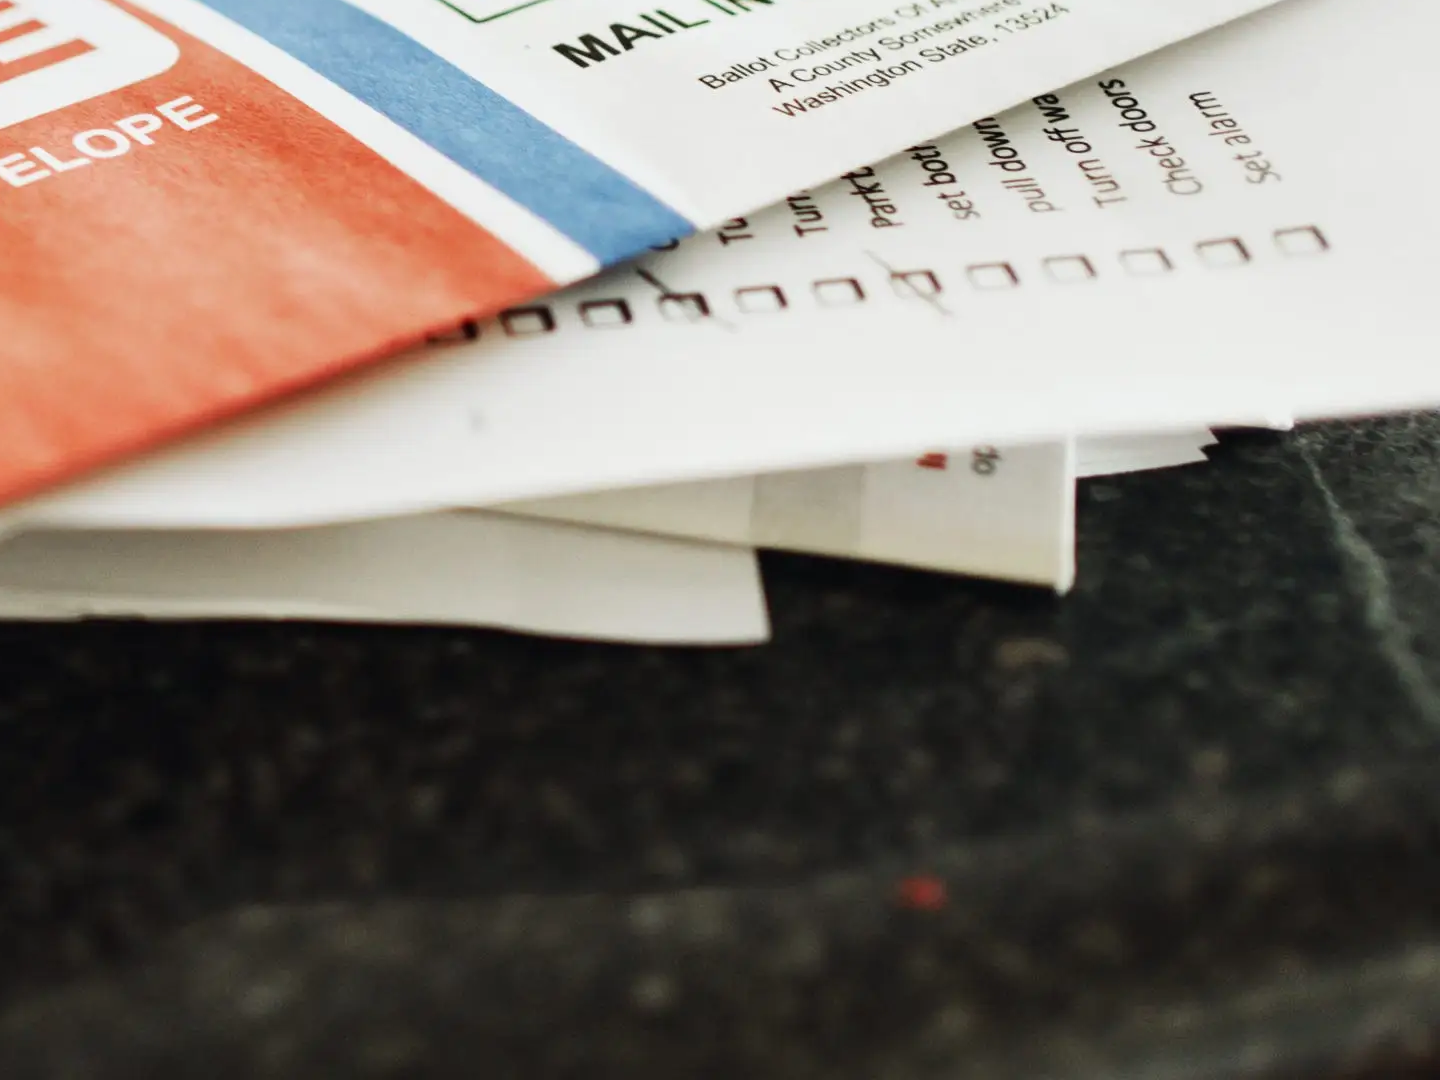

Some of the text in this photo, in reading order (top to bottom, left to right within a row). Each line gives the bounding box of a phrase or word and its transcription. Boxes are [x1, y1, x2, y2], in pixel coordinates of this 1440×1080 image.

[551, 7, 711, 69] MAIL
[698, 49, 779, 90] Ballot
[773, 14, 896, 62] Collectors
[894, 1, 924, 22] Of
[767, 77, 795, 94] A
[790, 46, 883, 84] County
[771, 1, 1070, 119] Washington State, 13524
[970, 116, 1062, 214] pull down
[1042, 127, 1093, 155] off
[1097, 77, 1205, 197] Check doors
[1188, 90, 1282, 186] Set alarm
[937, 190, 981, 221] set
[1078, 157, 1128, 209] Turn
